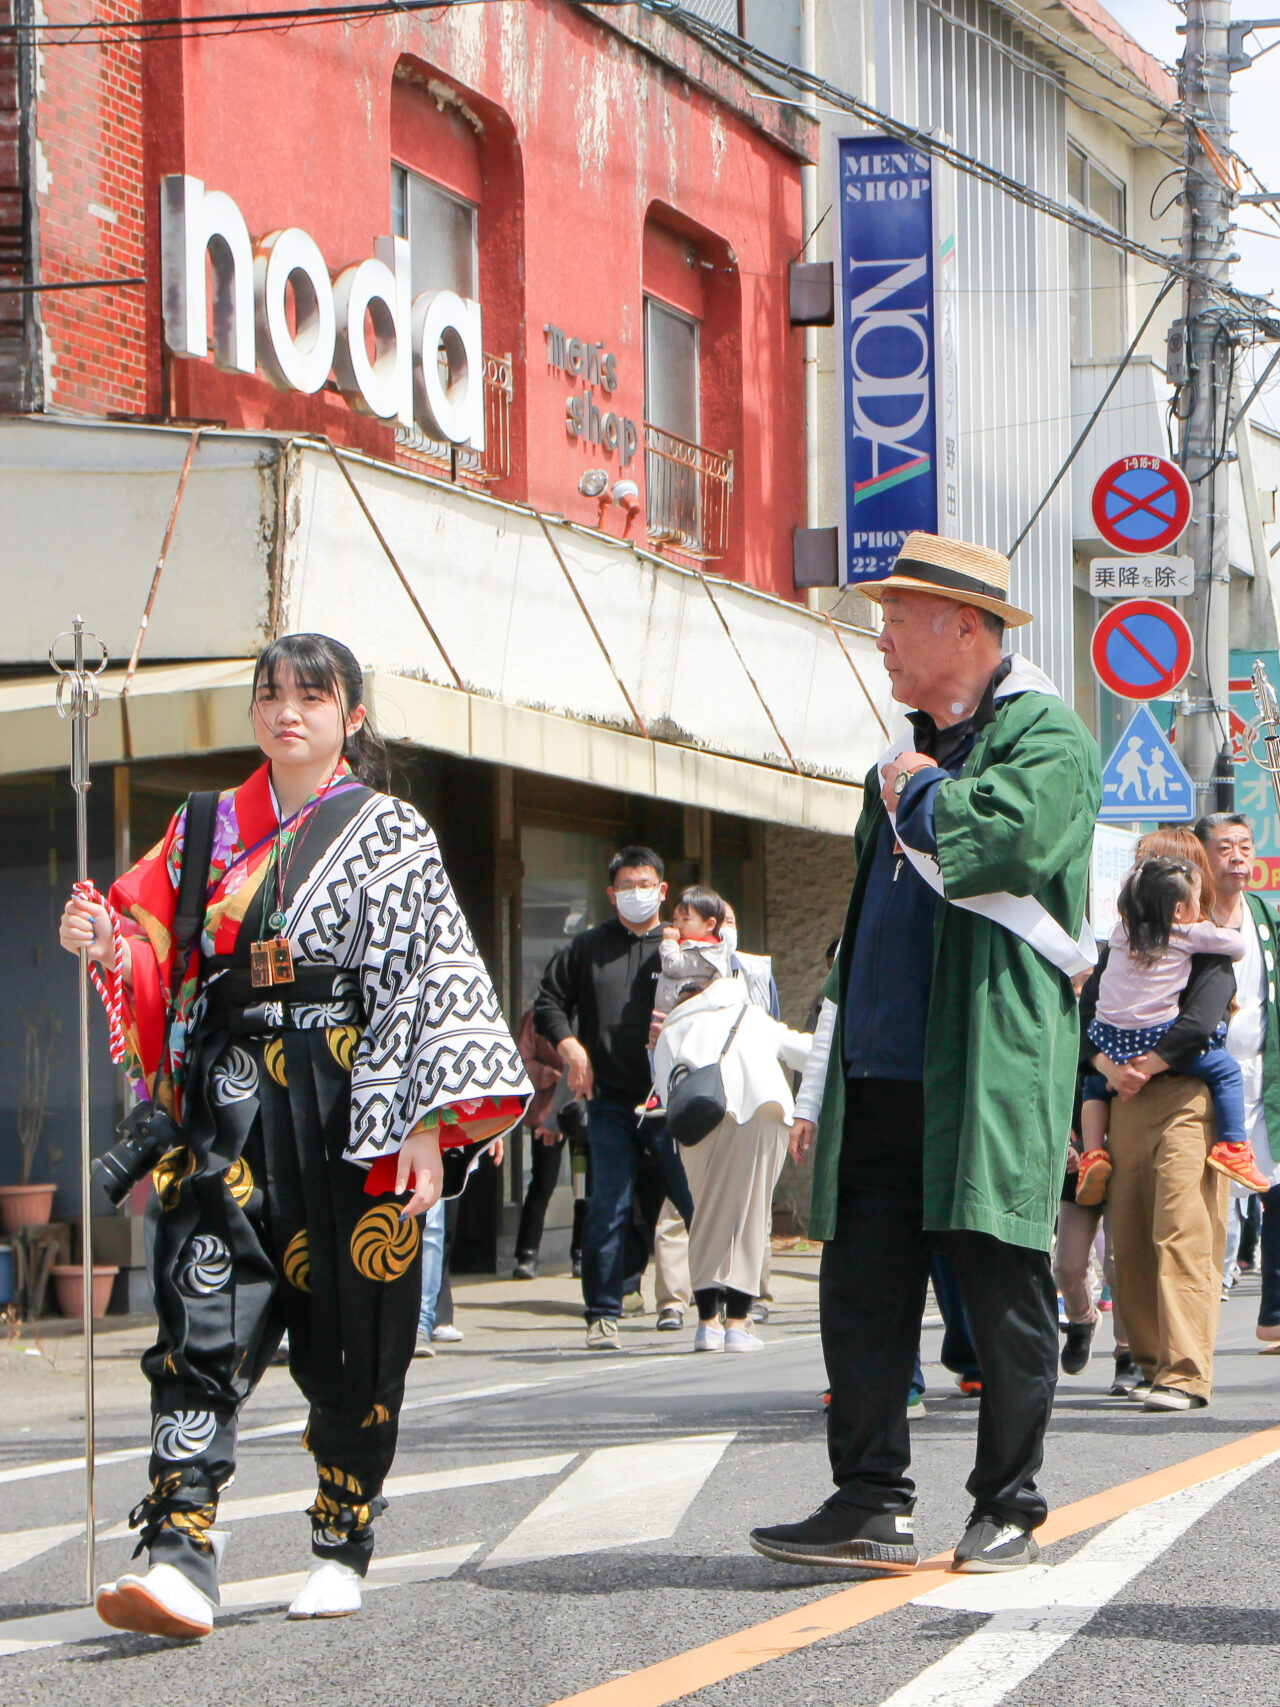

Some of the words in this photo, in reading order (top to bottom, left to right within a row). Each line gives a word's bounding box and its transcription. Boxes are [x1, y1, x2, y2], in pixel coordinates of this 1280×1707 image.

[845, 153, 930, 176] MEN'S
[846, 179, 930, 202] SHOP
[161, 174, 485, 452] noda
[544, 323, 618, 392] men's
[850, 252, 931, 506] NODA
[566, 390, 637, 467] shop
[1124, 457, 1138, 471] 7-9
[1140, 457, 1160, 470] 16-18
[1095, 566, 1188, 588] 乗降を除く
